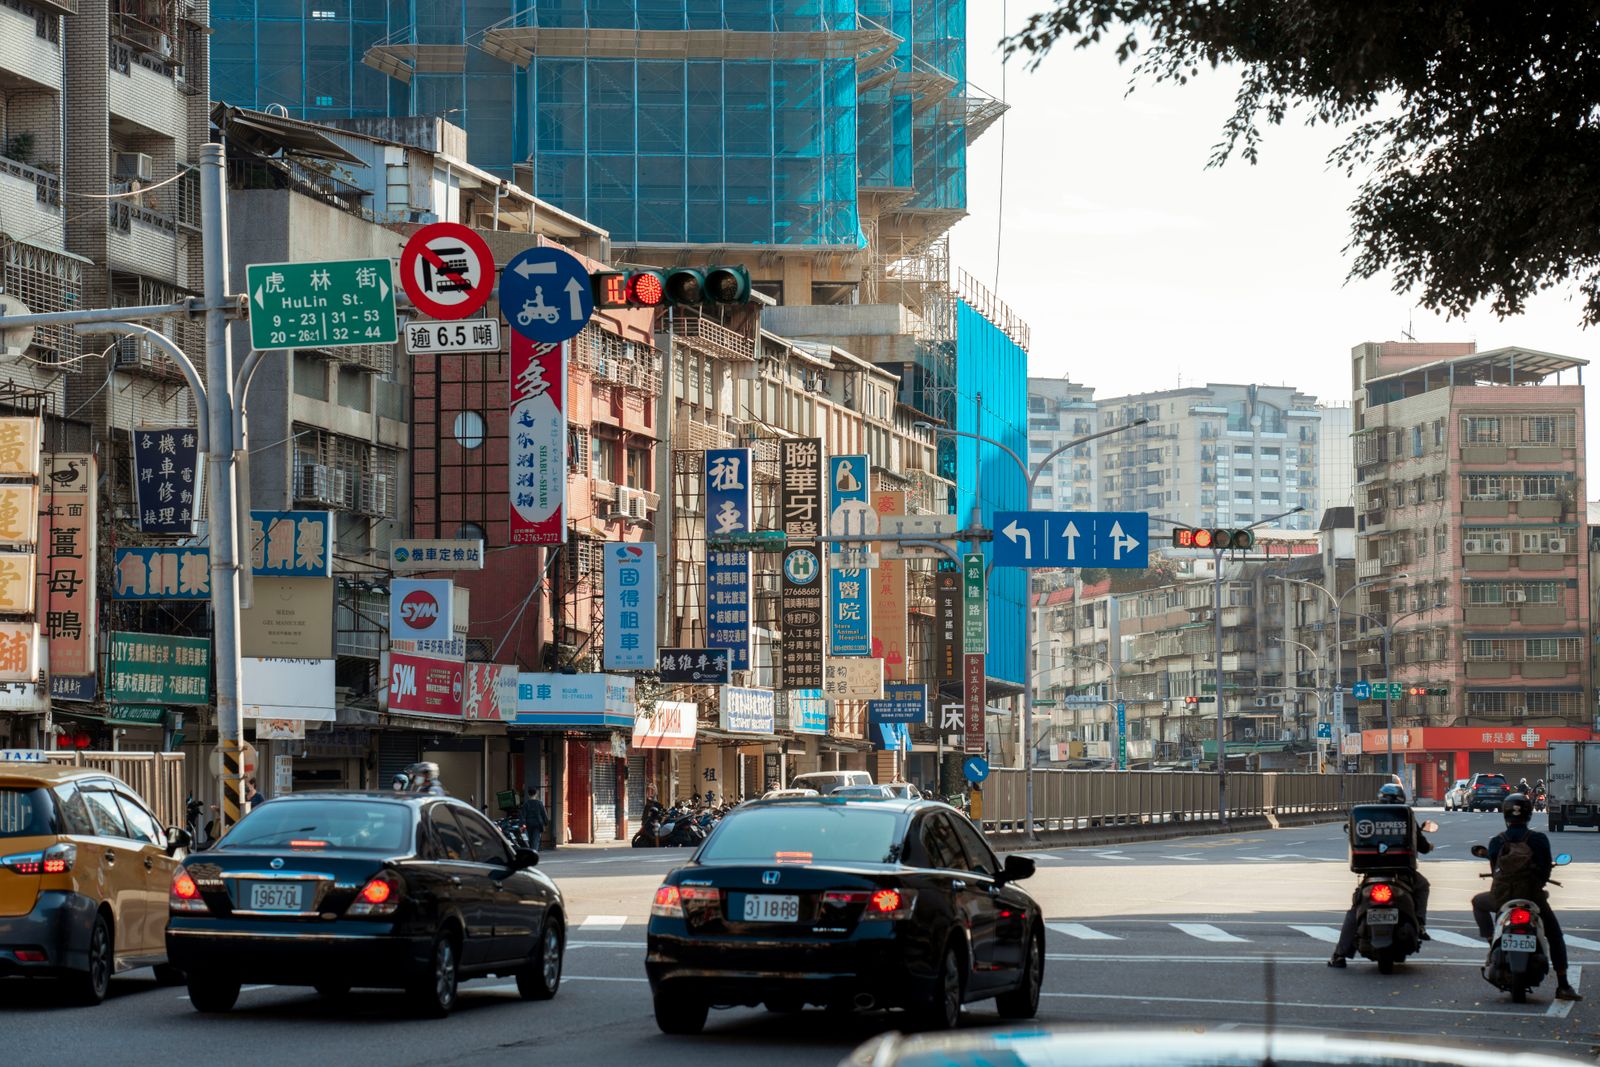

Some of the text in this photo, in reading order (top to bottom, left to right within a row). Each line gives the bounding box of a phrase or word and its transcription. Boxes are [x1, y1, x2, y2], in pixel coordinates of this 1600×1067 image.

[281, 293, 364, 309] HuLin St.
[158, 433, 177, 525] 機車修理
[539, 445, 548, 510] SHABU-SHABU
[47, 503, 84, 517] 紅面
[513, 533, 558, 542] 02-2763-7272
[411, 547, 479, 561] 機車定檢站
[46, 527, 84, 641] 薑母鴨
[784, 587, 820, 596] 27668689
[968, 567, 980, 616] 松隆路
[400, 602, 438, 622] SYM
[619, 567, 640, 651] 固得租車
[391, 663, 417, 703] SYM
[1482, 732, 1515, 743] 康是美
[5, 752, 40, 761] TAXI
[1375, 821, 1407, 829] EXPRESS
